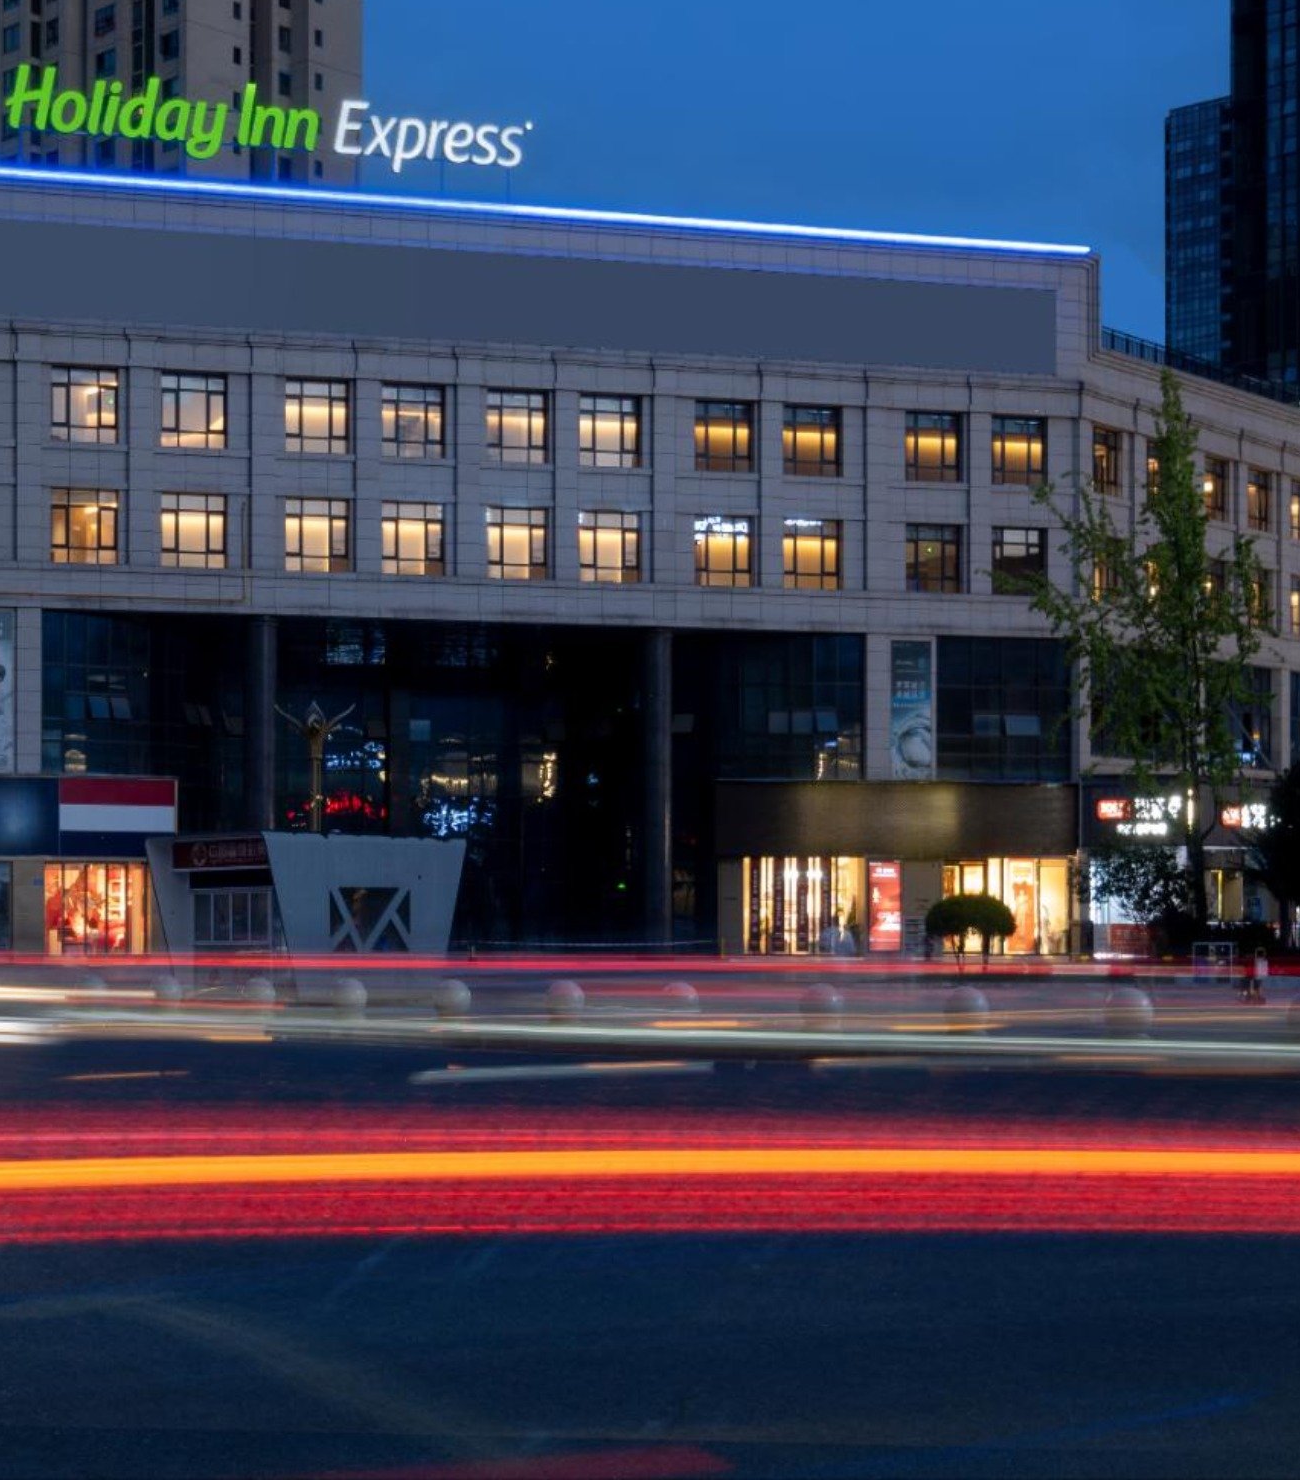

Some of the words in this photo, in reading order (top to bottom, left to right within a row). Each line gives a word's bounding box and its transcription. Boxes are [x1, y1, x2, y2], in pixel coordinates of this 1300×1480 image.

[5, 63, 228, 161] Holiday
[237, 83, 320, 152] Inn
[333, 100, 526, 173] Express
